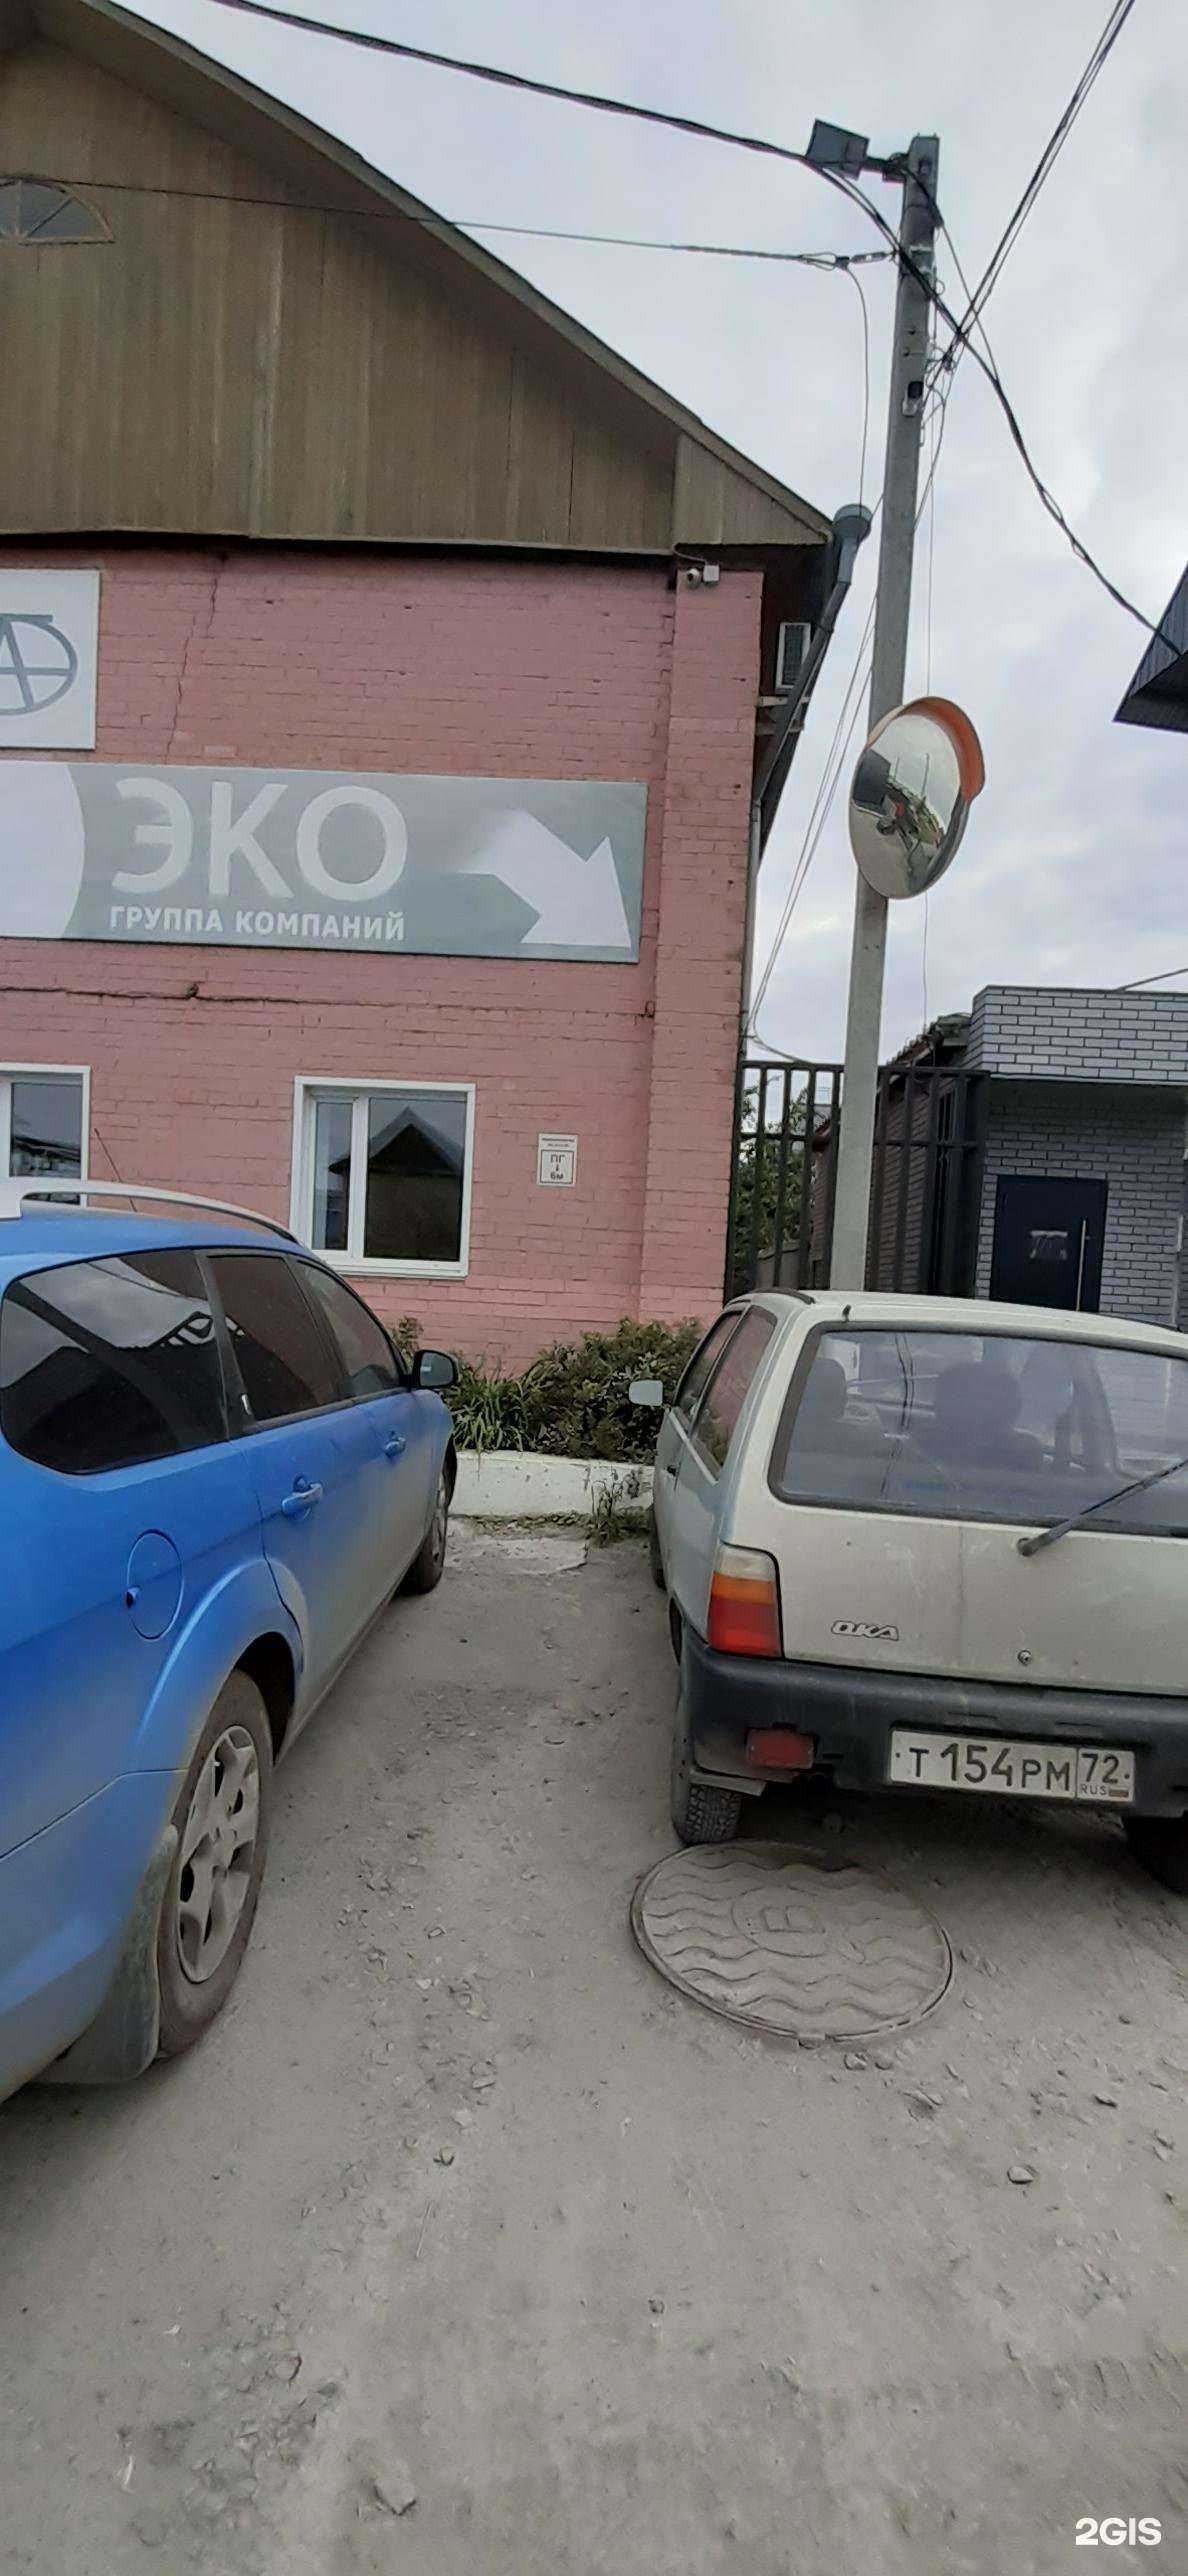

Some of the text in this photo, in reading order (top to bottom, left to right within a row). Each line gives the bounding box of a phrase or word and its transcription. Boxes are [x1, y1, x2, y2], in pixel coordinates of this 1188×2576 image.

[111, 777, 408, 902] ЭКО
[109, 905, 406, 941] ГРУППА КОМПАНИЙ
[550, 1154, 566, 1163] ПГ
[1081, 1753, 1121, 1784] 72
[1080, 1783, 1108, 1797] RUS
